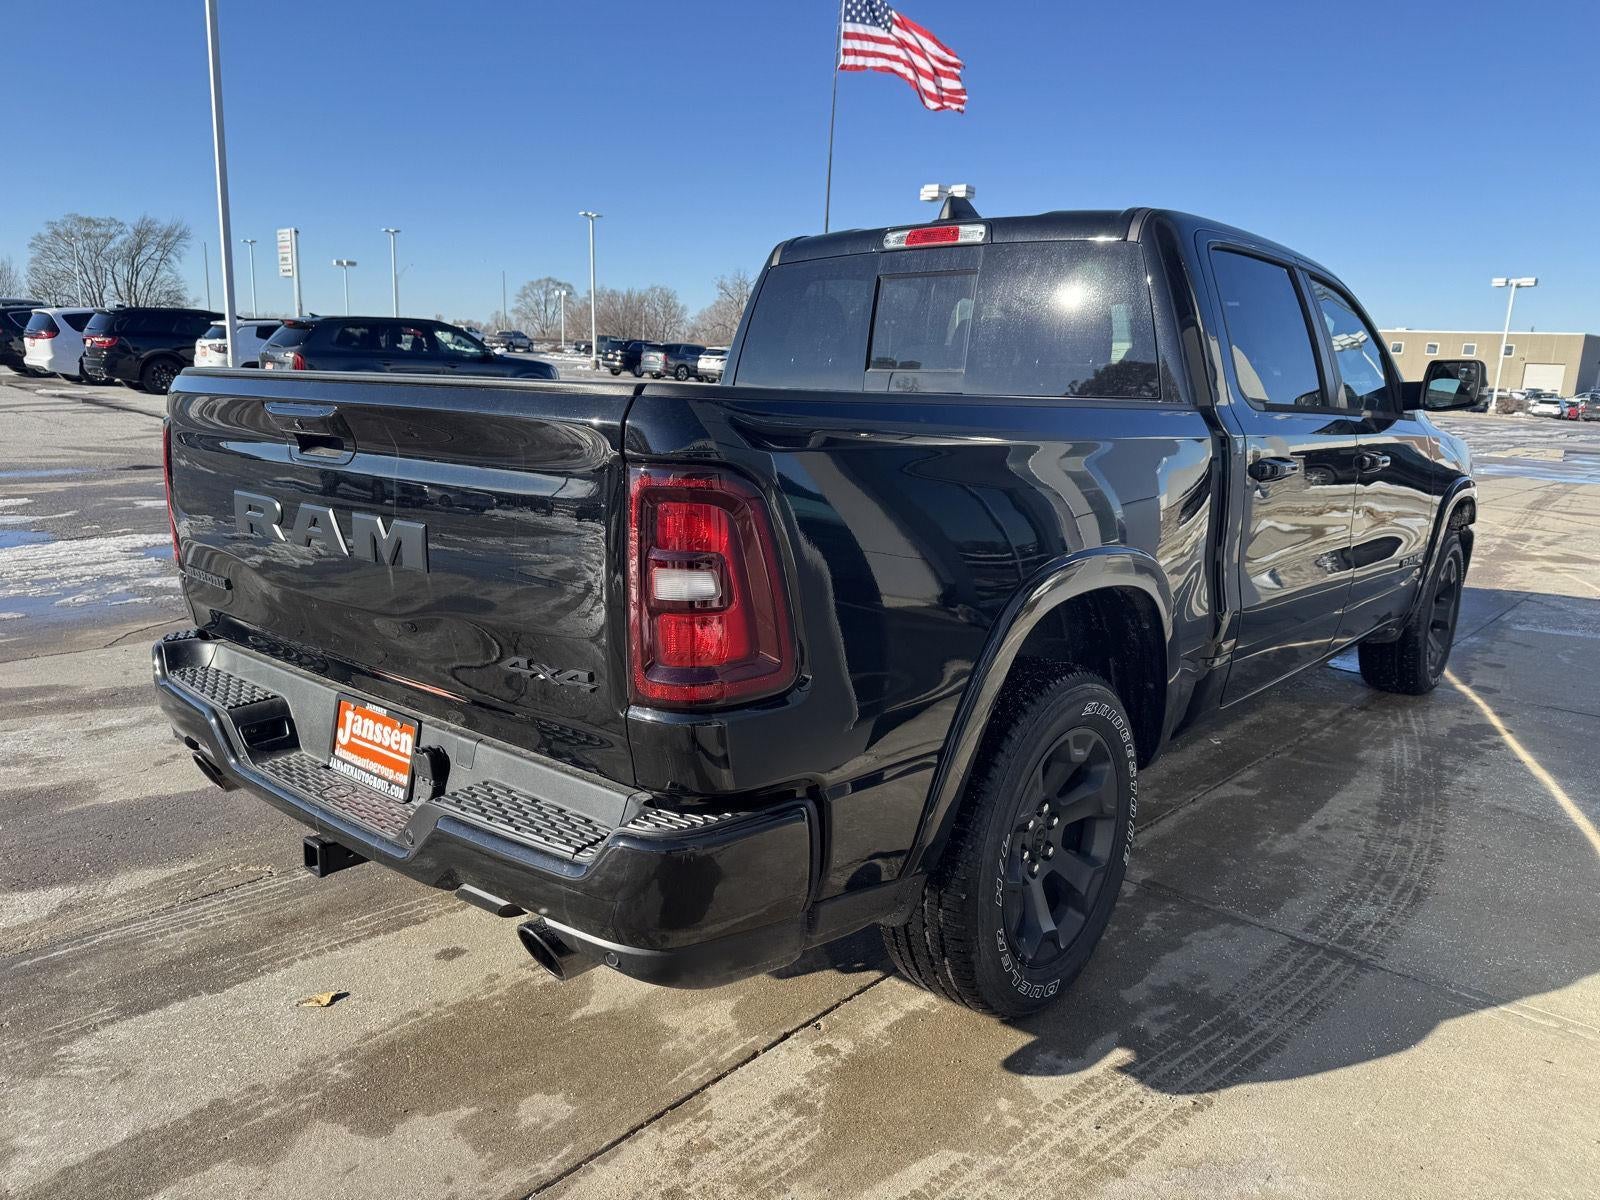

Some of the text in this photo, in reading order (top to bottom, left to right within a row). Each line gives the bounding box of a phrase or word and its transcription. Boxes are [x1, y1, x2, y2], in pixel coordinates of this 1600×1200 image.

[233, 489, 429, 574] RAM
[337, 710, 413, 756] Janssen
[1082, 702, 1137, 866] BRIDGESTONE
[996, 928, 1061, 998] DUELER
